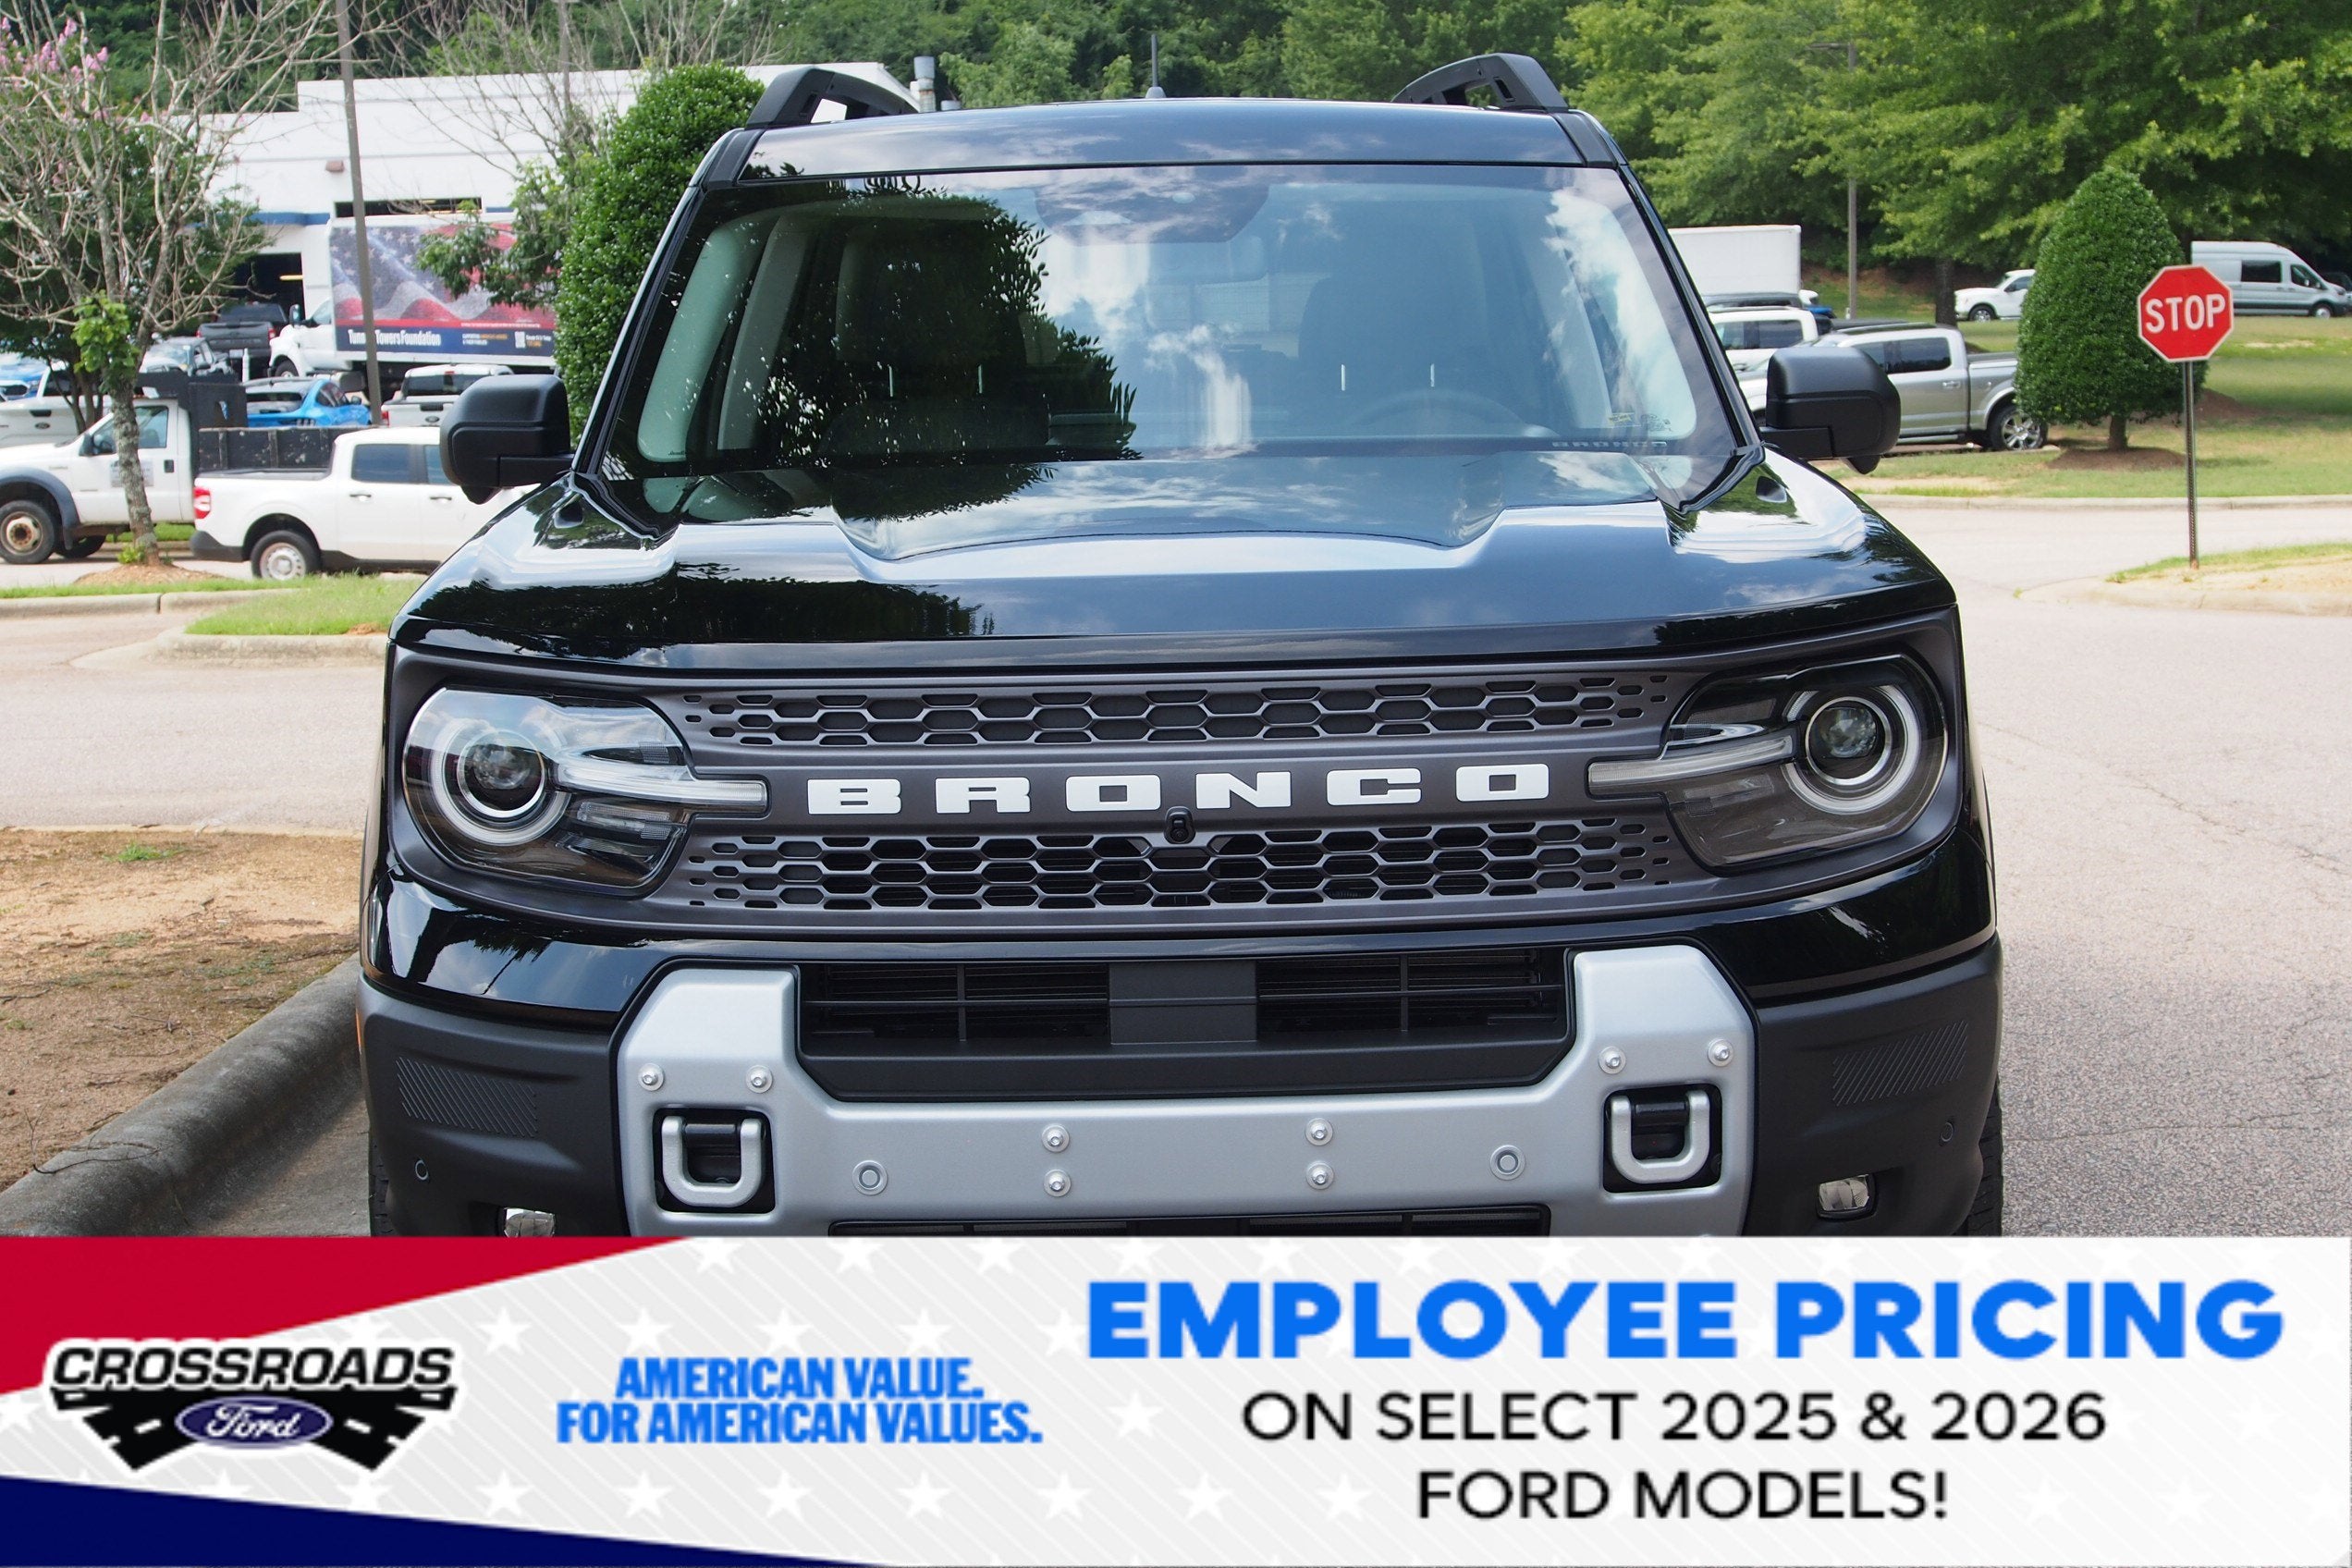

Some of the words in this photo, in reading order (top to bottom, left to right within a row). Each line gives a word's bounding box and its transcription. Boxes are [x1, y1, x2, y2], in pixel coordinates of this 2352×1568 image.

[2145, 293, 2226, 334] STOP
[374, 329, 400, 345] Towers
[399, 329, 442, 347] Foundation
[807, 764, 1550, 815] BRONCO
